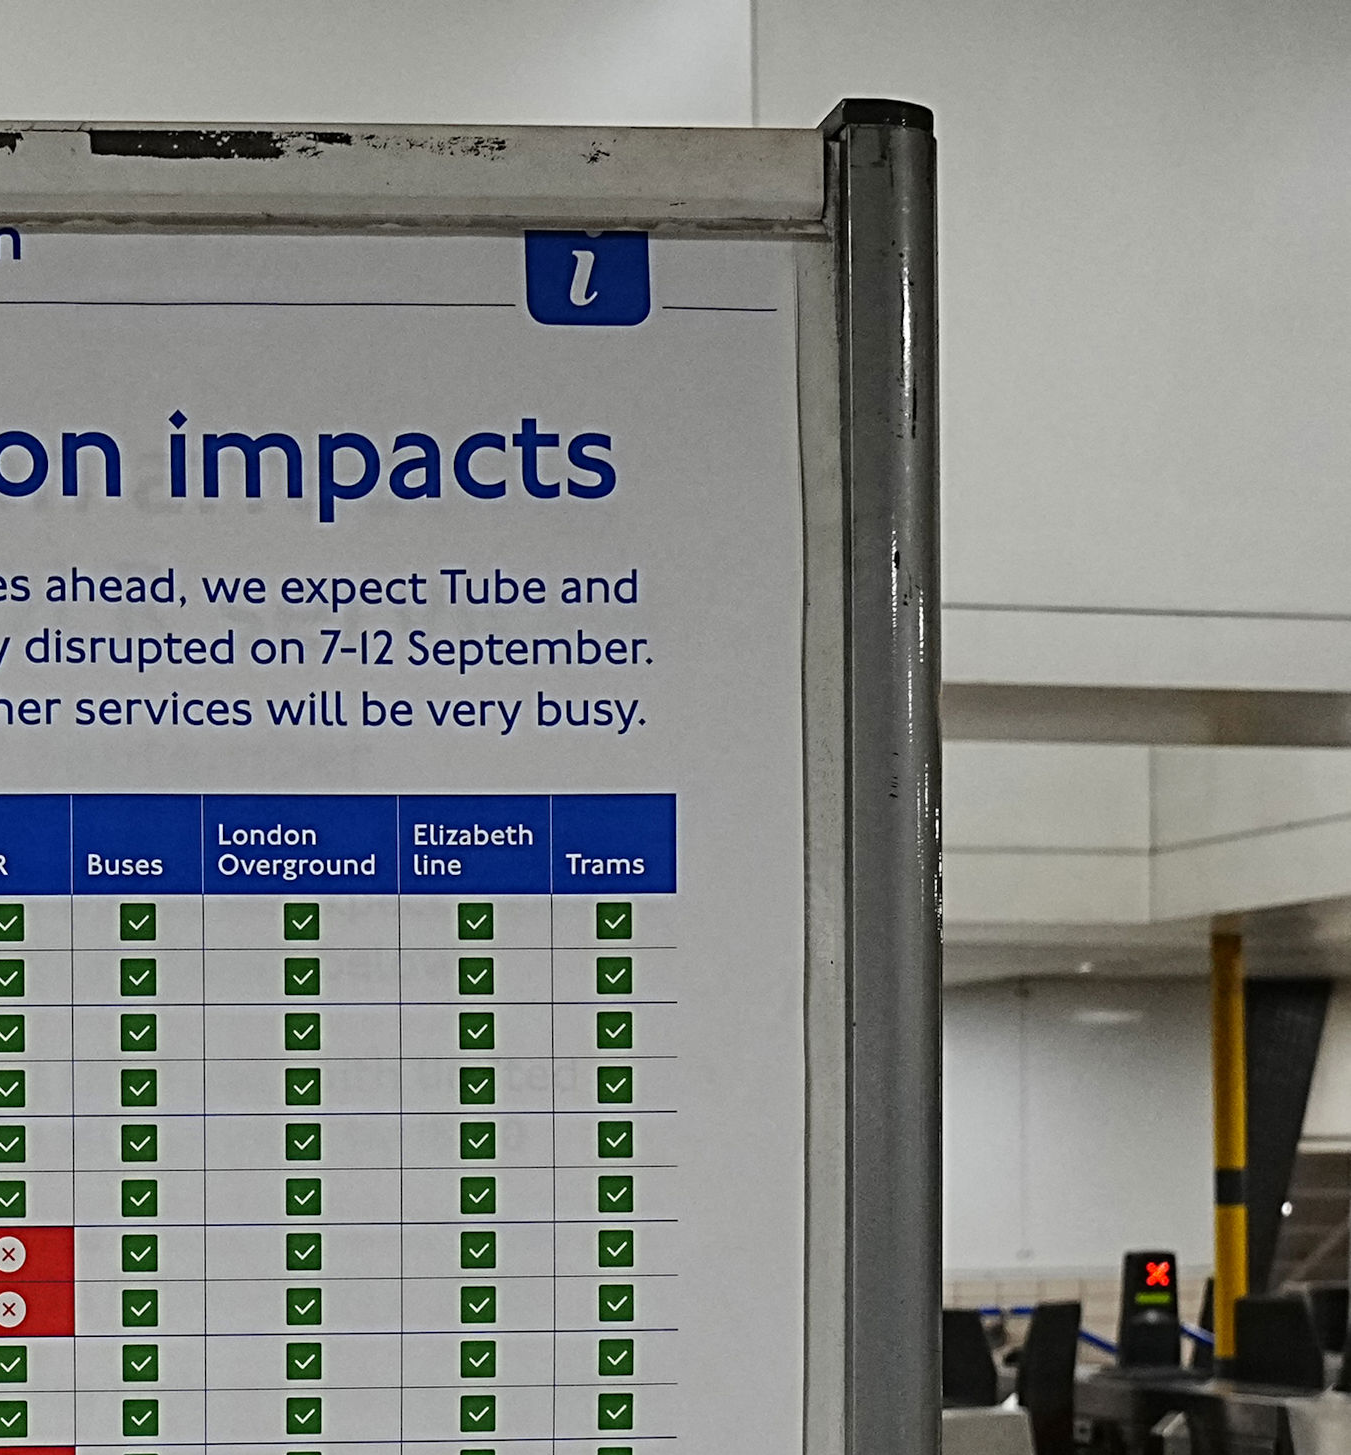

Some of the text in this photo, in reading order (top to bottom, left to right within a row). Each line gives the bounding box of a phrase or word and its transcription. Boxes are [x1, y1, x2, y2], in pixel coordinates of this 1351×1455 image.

[168, 409, 617, 524] impacts
[45, 566, 187, 609] ahead,
[201, 577, 266, 605] we
[280, 572, 428, 614] expect
[439, 568, 547, 605] Tube
[560, 568, 638, 605] and
[24, 627, 235, 674] disrupted
[250, 638, 305, 665] on
[319, 629, 394, 666] 7-12
[407, 628, 654, 675] September.
[75, 690, 253, 727] services
[265, 690, 348, 727] will
[361, 690, 413, 727] be
[426, 699, 523, 736] very
[537, 690, 647, 735] busy.
[218, 823, 317, 846] London
[414, 823, 533, 846] Elizabeth
[88, 853, 163, 876] Buses
[218, 853, 376, 881] Overground
[413, 853, 462, 876] line
[565, 853, 645, 875] Trams
